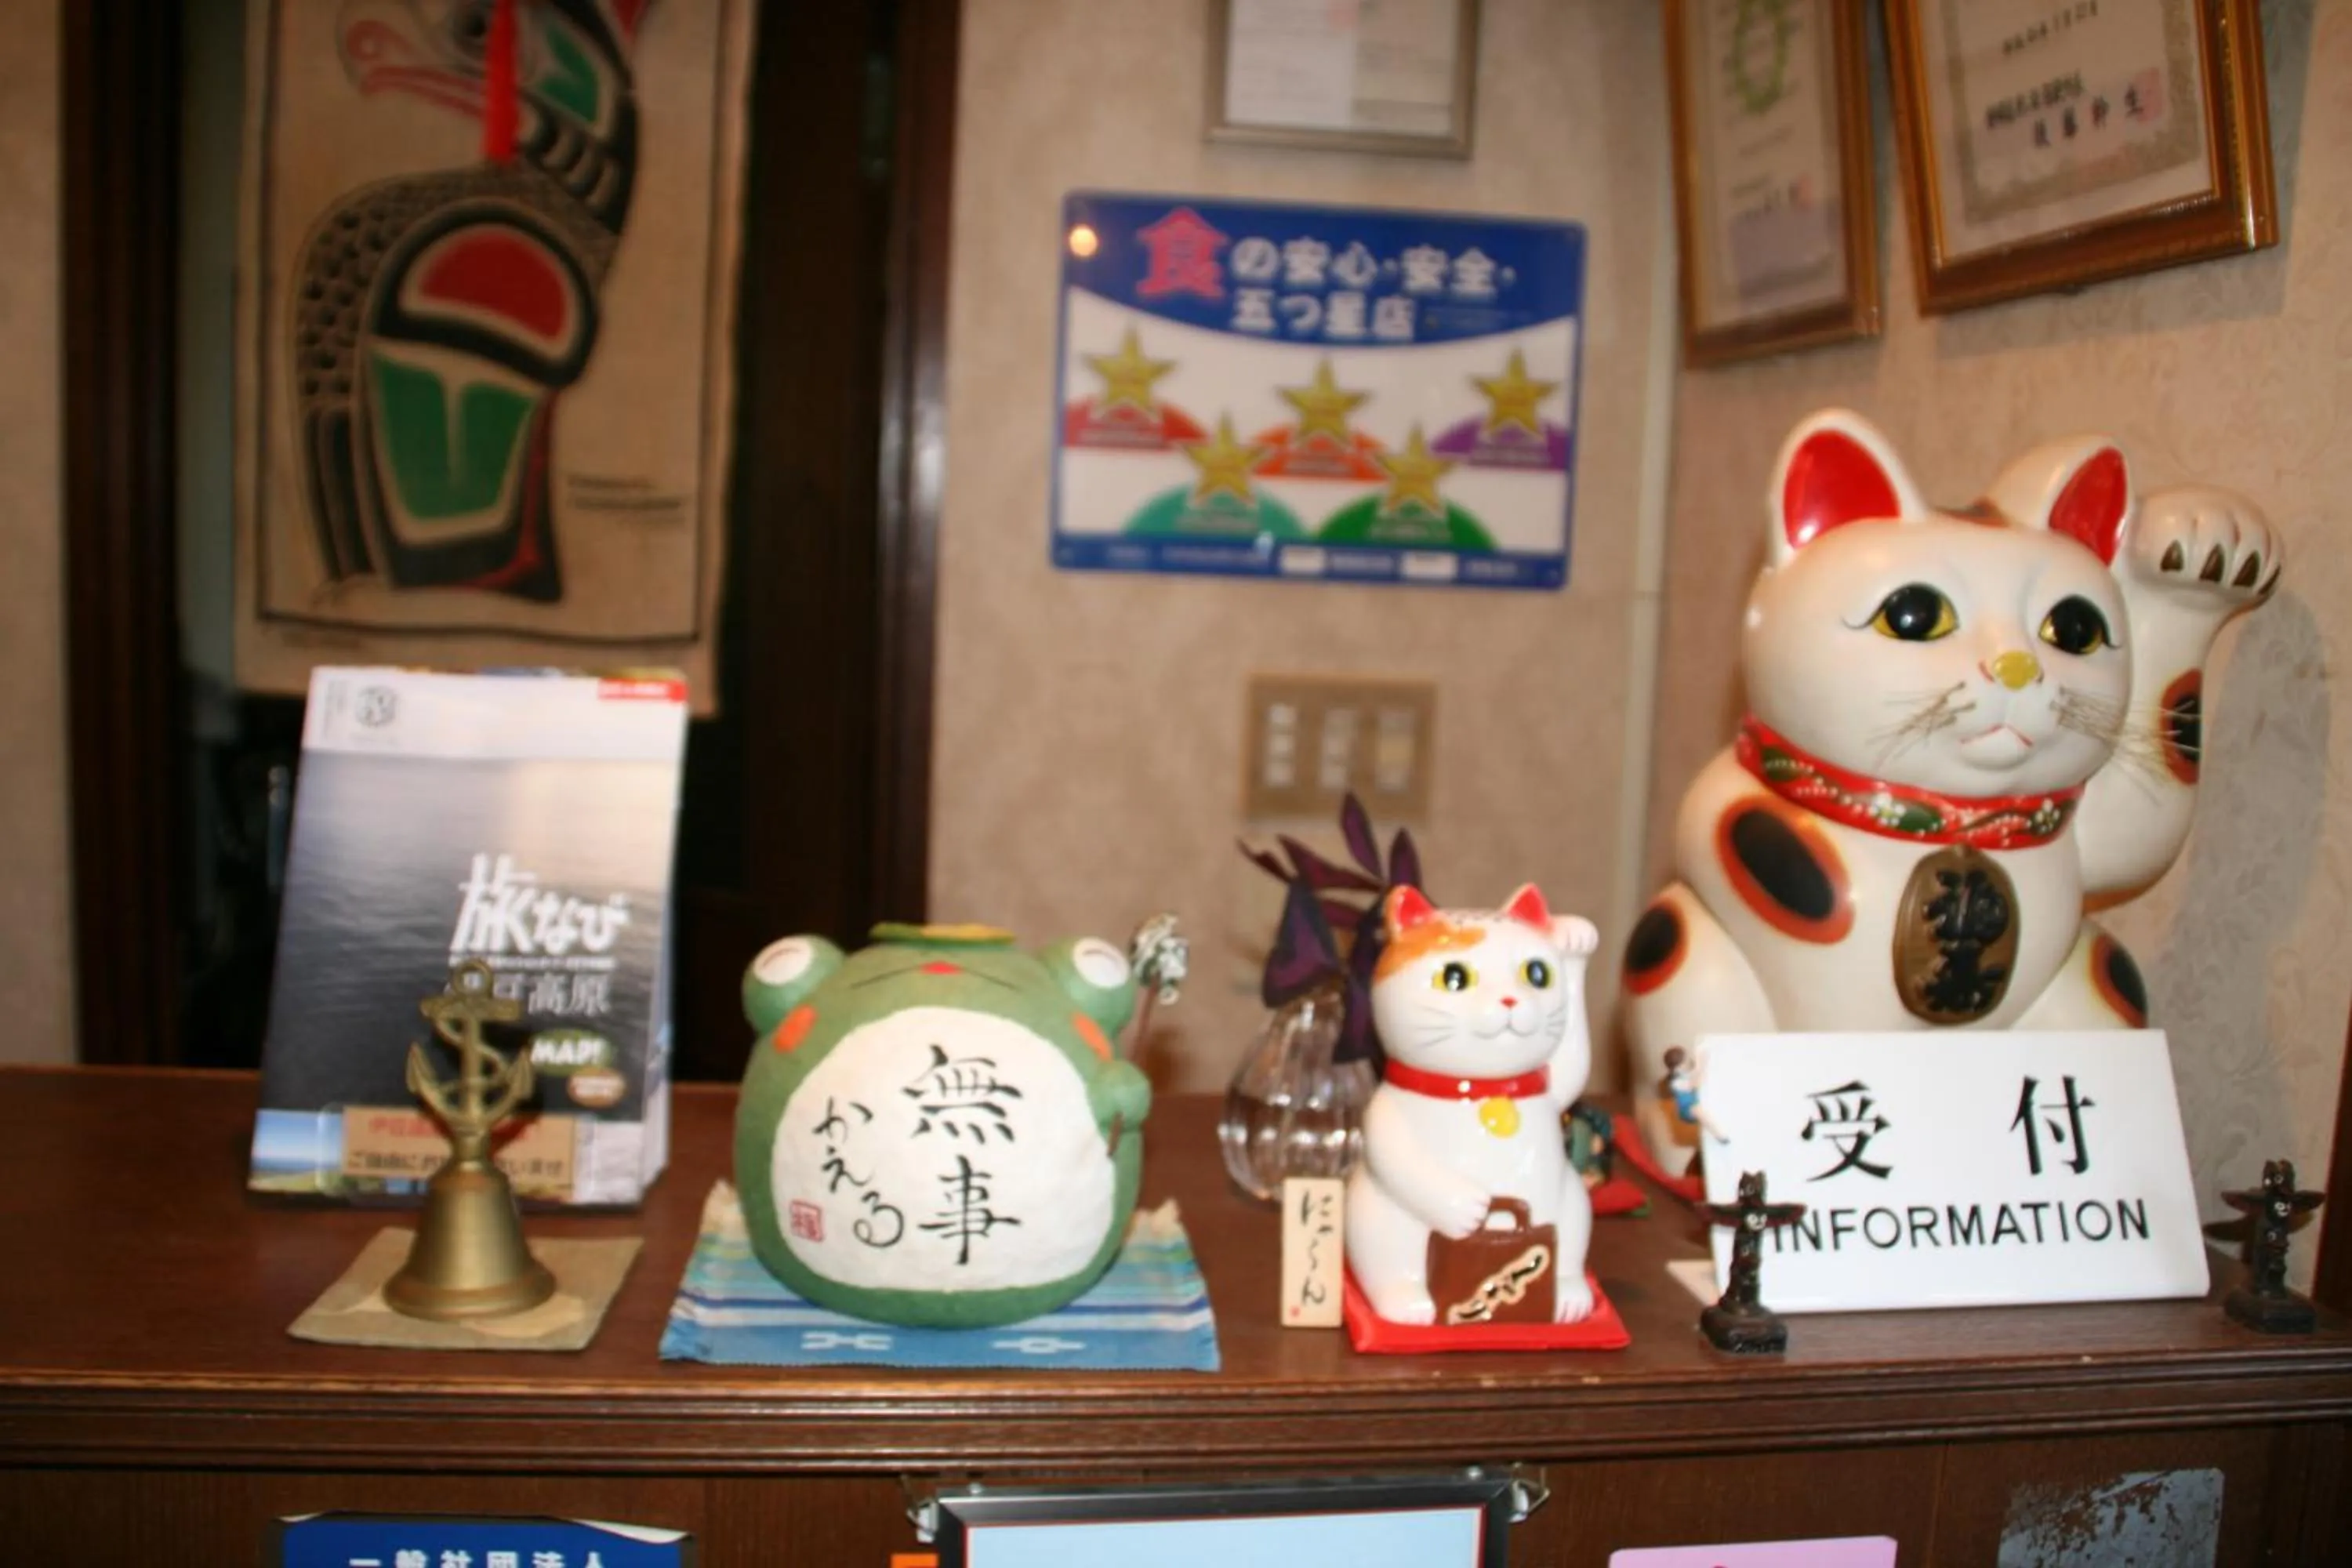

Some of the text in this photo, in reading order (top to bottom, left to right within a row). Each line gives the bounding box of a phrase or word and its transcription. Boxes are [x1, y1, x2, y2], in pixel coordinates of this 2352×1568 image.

[448, 851, 631, 955] 旅なび
[811, 1095, 905, 1248] かえる
[900, 1044, 1023, 1266] 無事
[1773, 1198, 2151, 1253] INFORMATION
